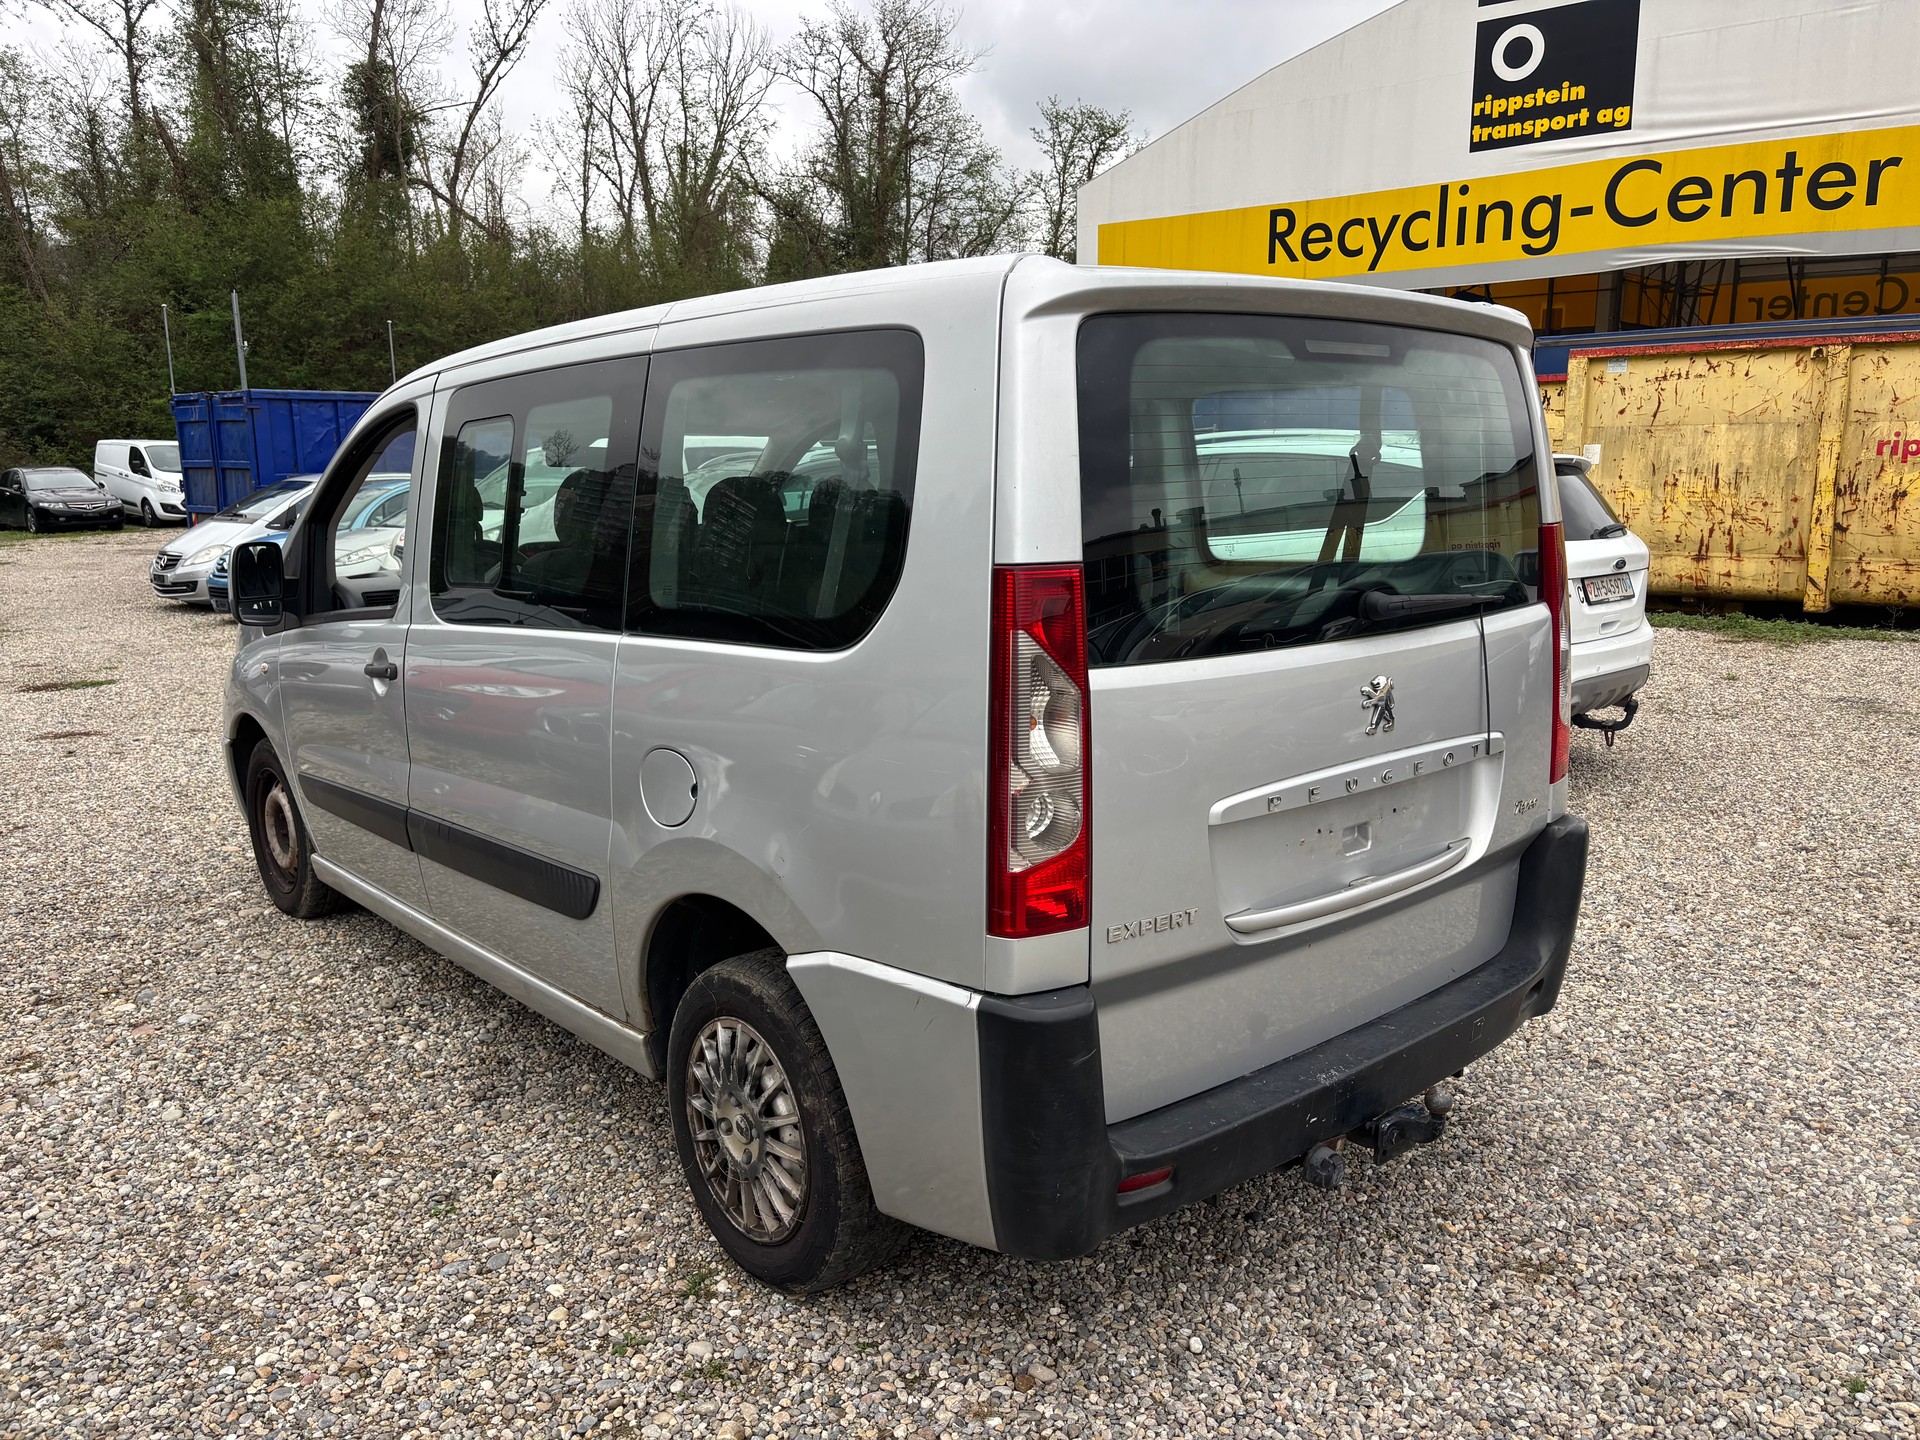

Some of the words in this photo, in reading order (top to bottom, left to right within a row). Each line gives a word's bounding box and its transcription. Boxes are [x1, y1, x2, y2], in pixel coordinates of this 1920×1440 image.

[1473, 81, 1586, 119] rippstein
[1472, 108, 1590, 142] transport
[1597, 106, 1631, 127] ag
[1267, 151, 1903, 271] Recycling-Center
[1576, 585, 1585, 604] C
[1267, 743, 1481, 812] PEUGEOT
[1107, 907, 1199, 944] EXPERT
